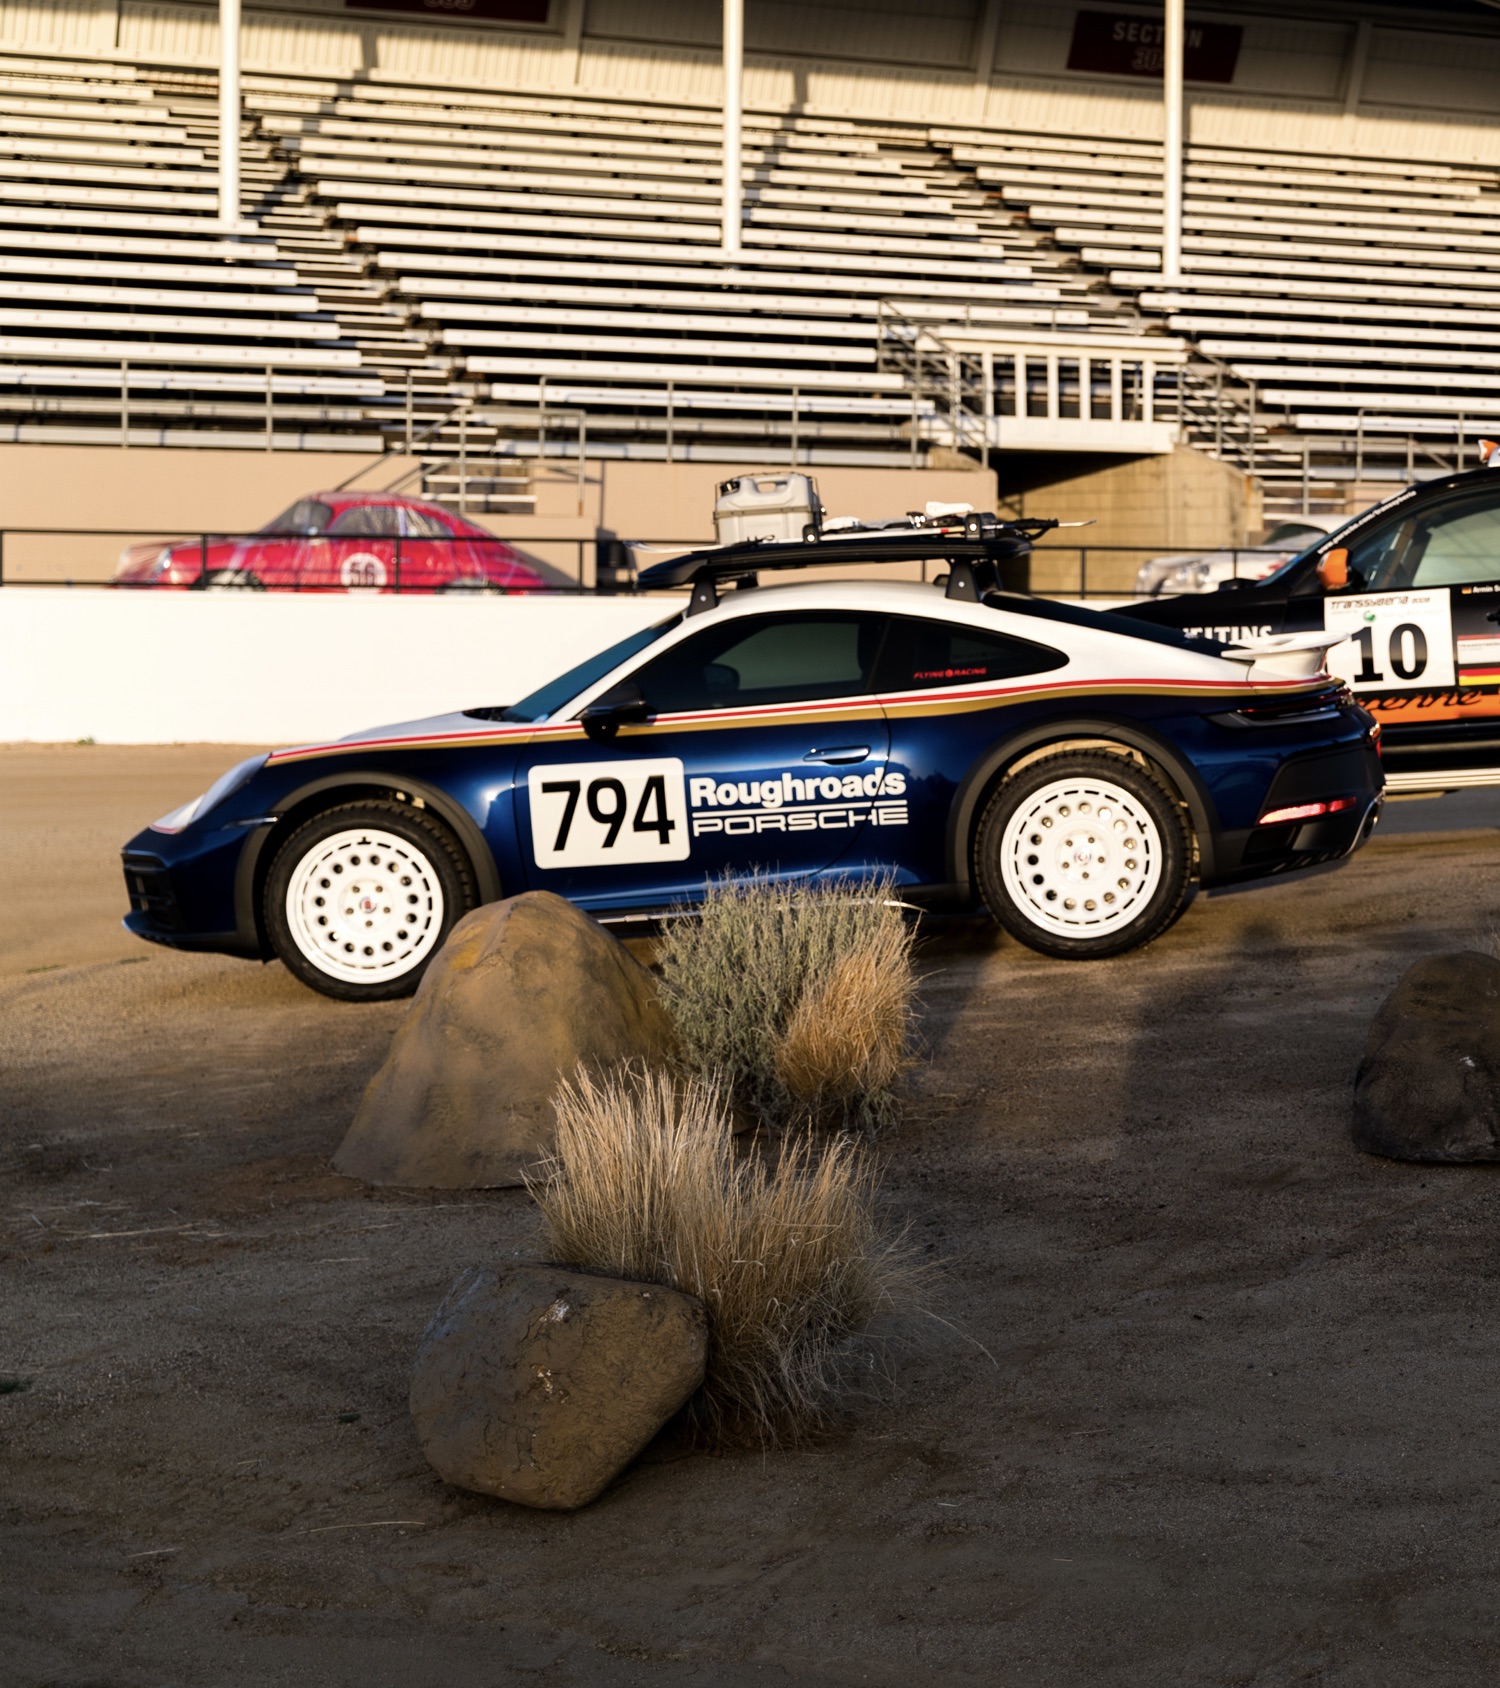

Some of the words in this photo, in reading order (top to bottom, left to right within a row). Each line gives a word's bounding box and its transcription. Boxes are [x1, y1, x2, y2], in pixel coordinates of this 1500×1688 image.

[1111, 20, 1204, 48] SECTN
[1131, 45, 1165, 71] 30
[1351, 623, 1428, 683] 10
[913, 669, 945, 680] FLYING
[953, 667, 988, 677] RACING
[689, 767, 908, 809] Roughroads
[541, 774, 676, 852] 794
[692, 806, 909, 837] PORSCHE
